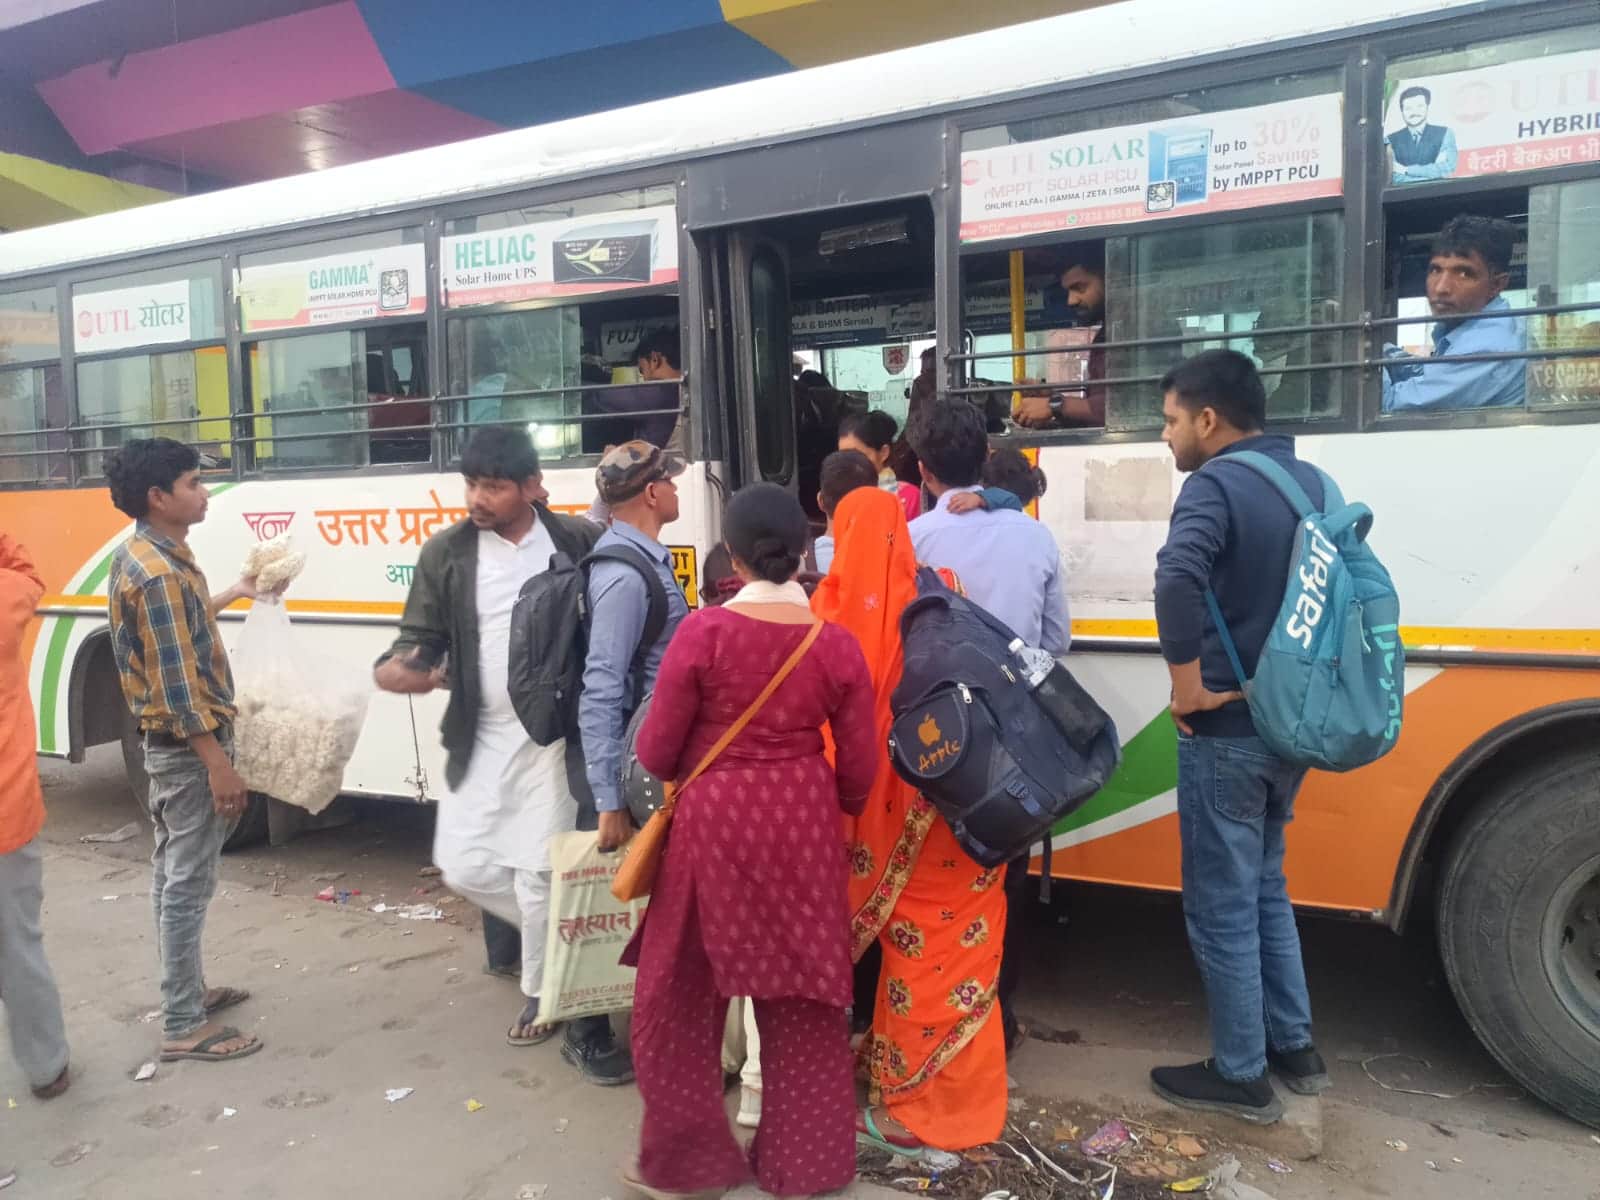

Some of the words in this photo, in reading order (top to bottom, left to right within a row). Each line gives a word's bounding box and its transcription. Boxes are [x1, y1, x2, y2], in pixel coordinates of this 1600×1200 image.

[1049, 138, 1145, 170] SOLAR
[1214, 143, 1231, 155] up
[1234, 139, 1248, 151] to
[1257, 149, 1320, 166] Savings
[1047, 171, 1099, 192] SOLAR
[1103, 167, 1139, 185] PCU
[1213, 176, 1230, 192] by
[1288, 164, 1320, 180] PCU
[1049, 192, 1081, 203] GAMMA
[1086, 188, 1108, 198] ZETA
[1113, 184, 1141, 194] SIGMA
[455, 232, 537, 271] HELIAC
[455, 274, 481, 286] Solar
[483, 271, 513, 283] Home
[515, 266, 538, 279] UPS
[137, 299, 187, 328] सोलर
[314, 508, 391, 547] उत्तर
[1286, 520, 1338, 650] safari
[918, 739, 961, 772] Apple
